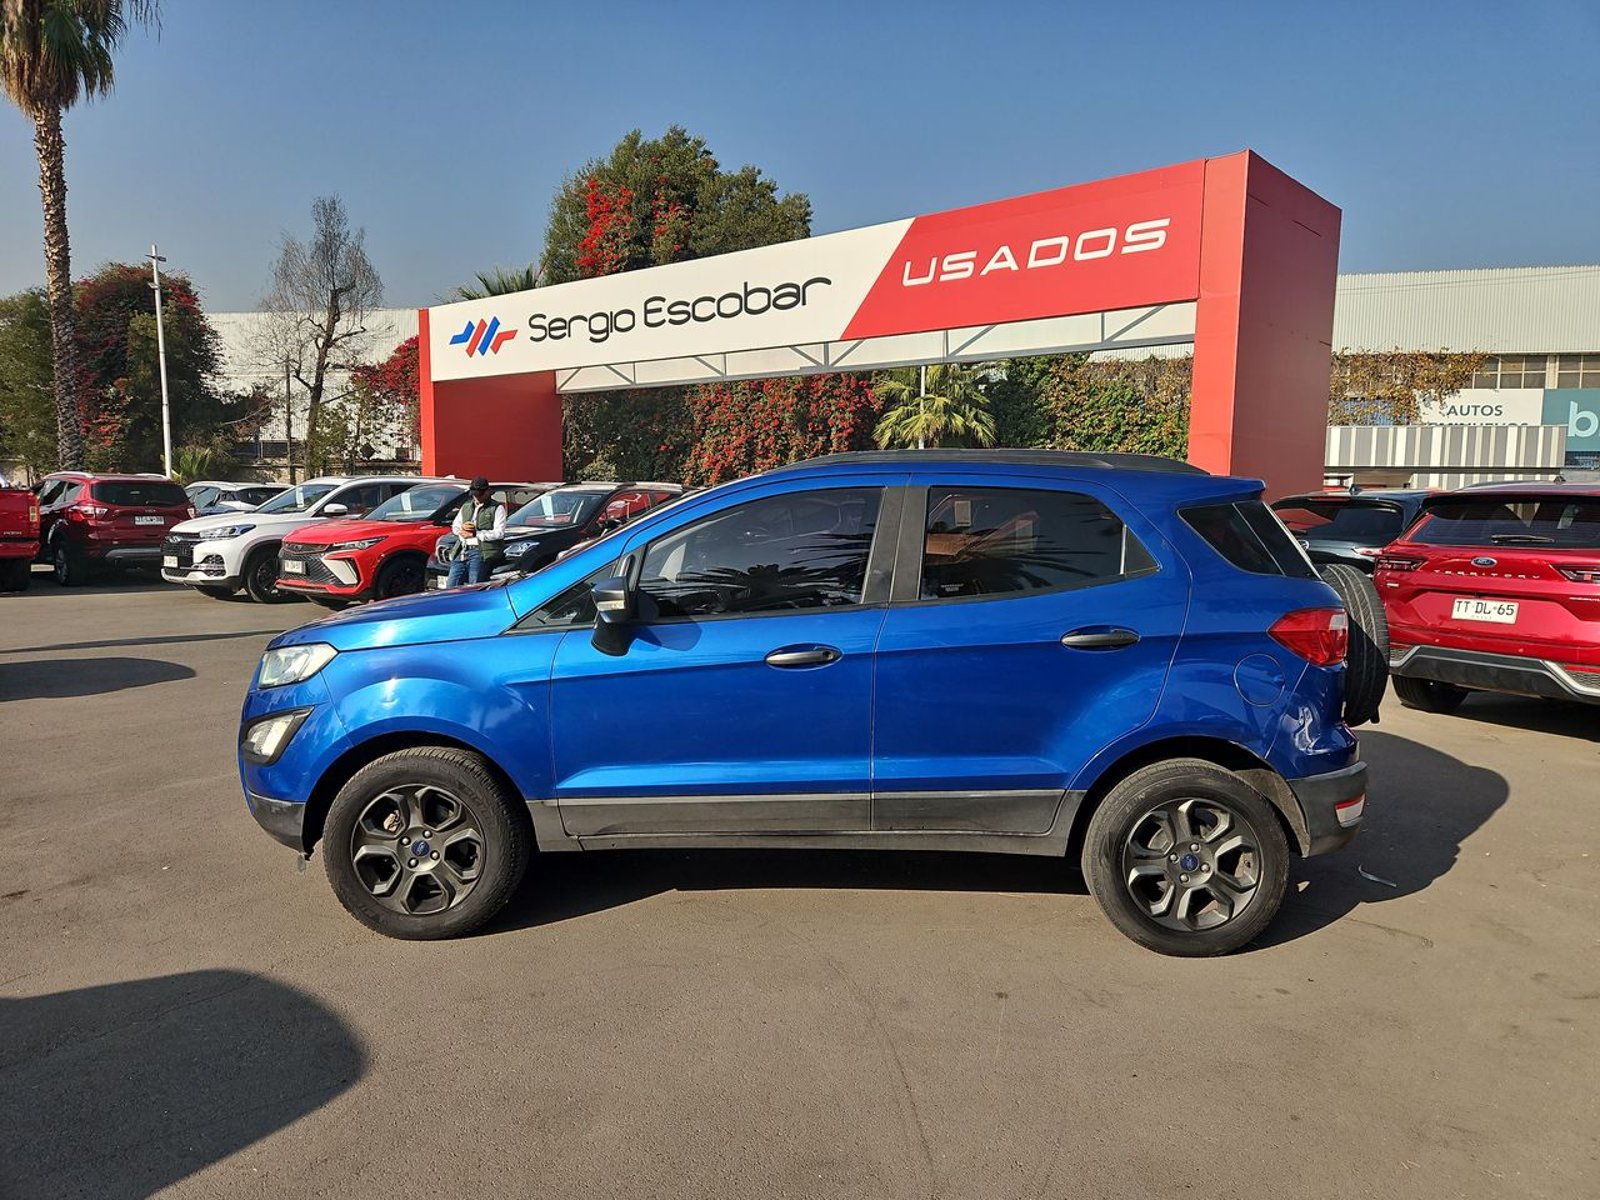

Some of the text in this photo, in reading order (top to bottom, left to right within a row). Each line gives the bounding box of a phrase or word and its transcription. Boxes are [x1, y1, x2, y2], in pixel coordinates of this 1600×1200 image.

[902, 217, 1171, 287] USADOS
[528, 276, 832, 343] Sergio Escobar
[1447, 404, 1503, 417] AUTOS
[1568, 400, 1600, 437] b
